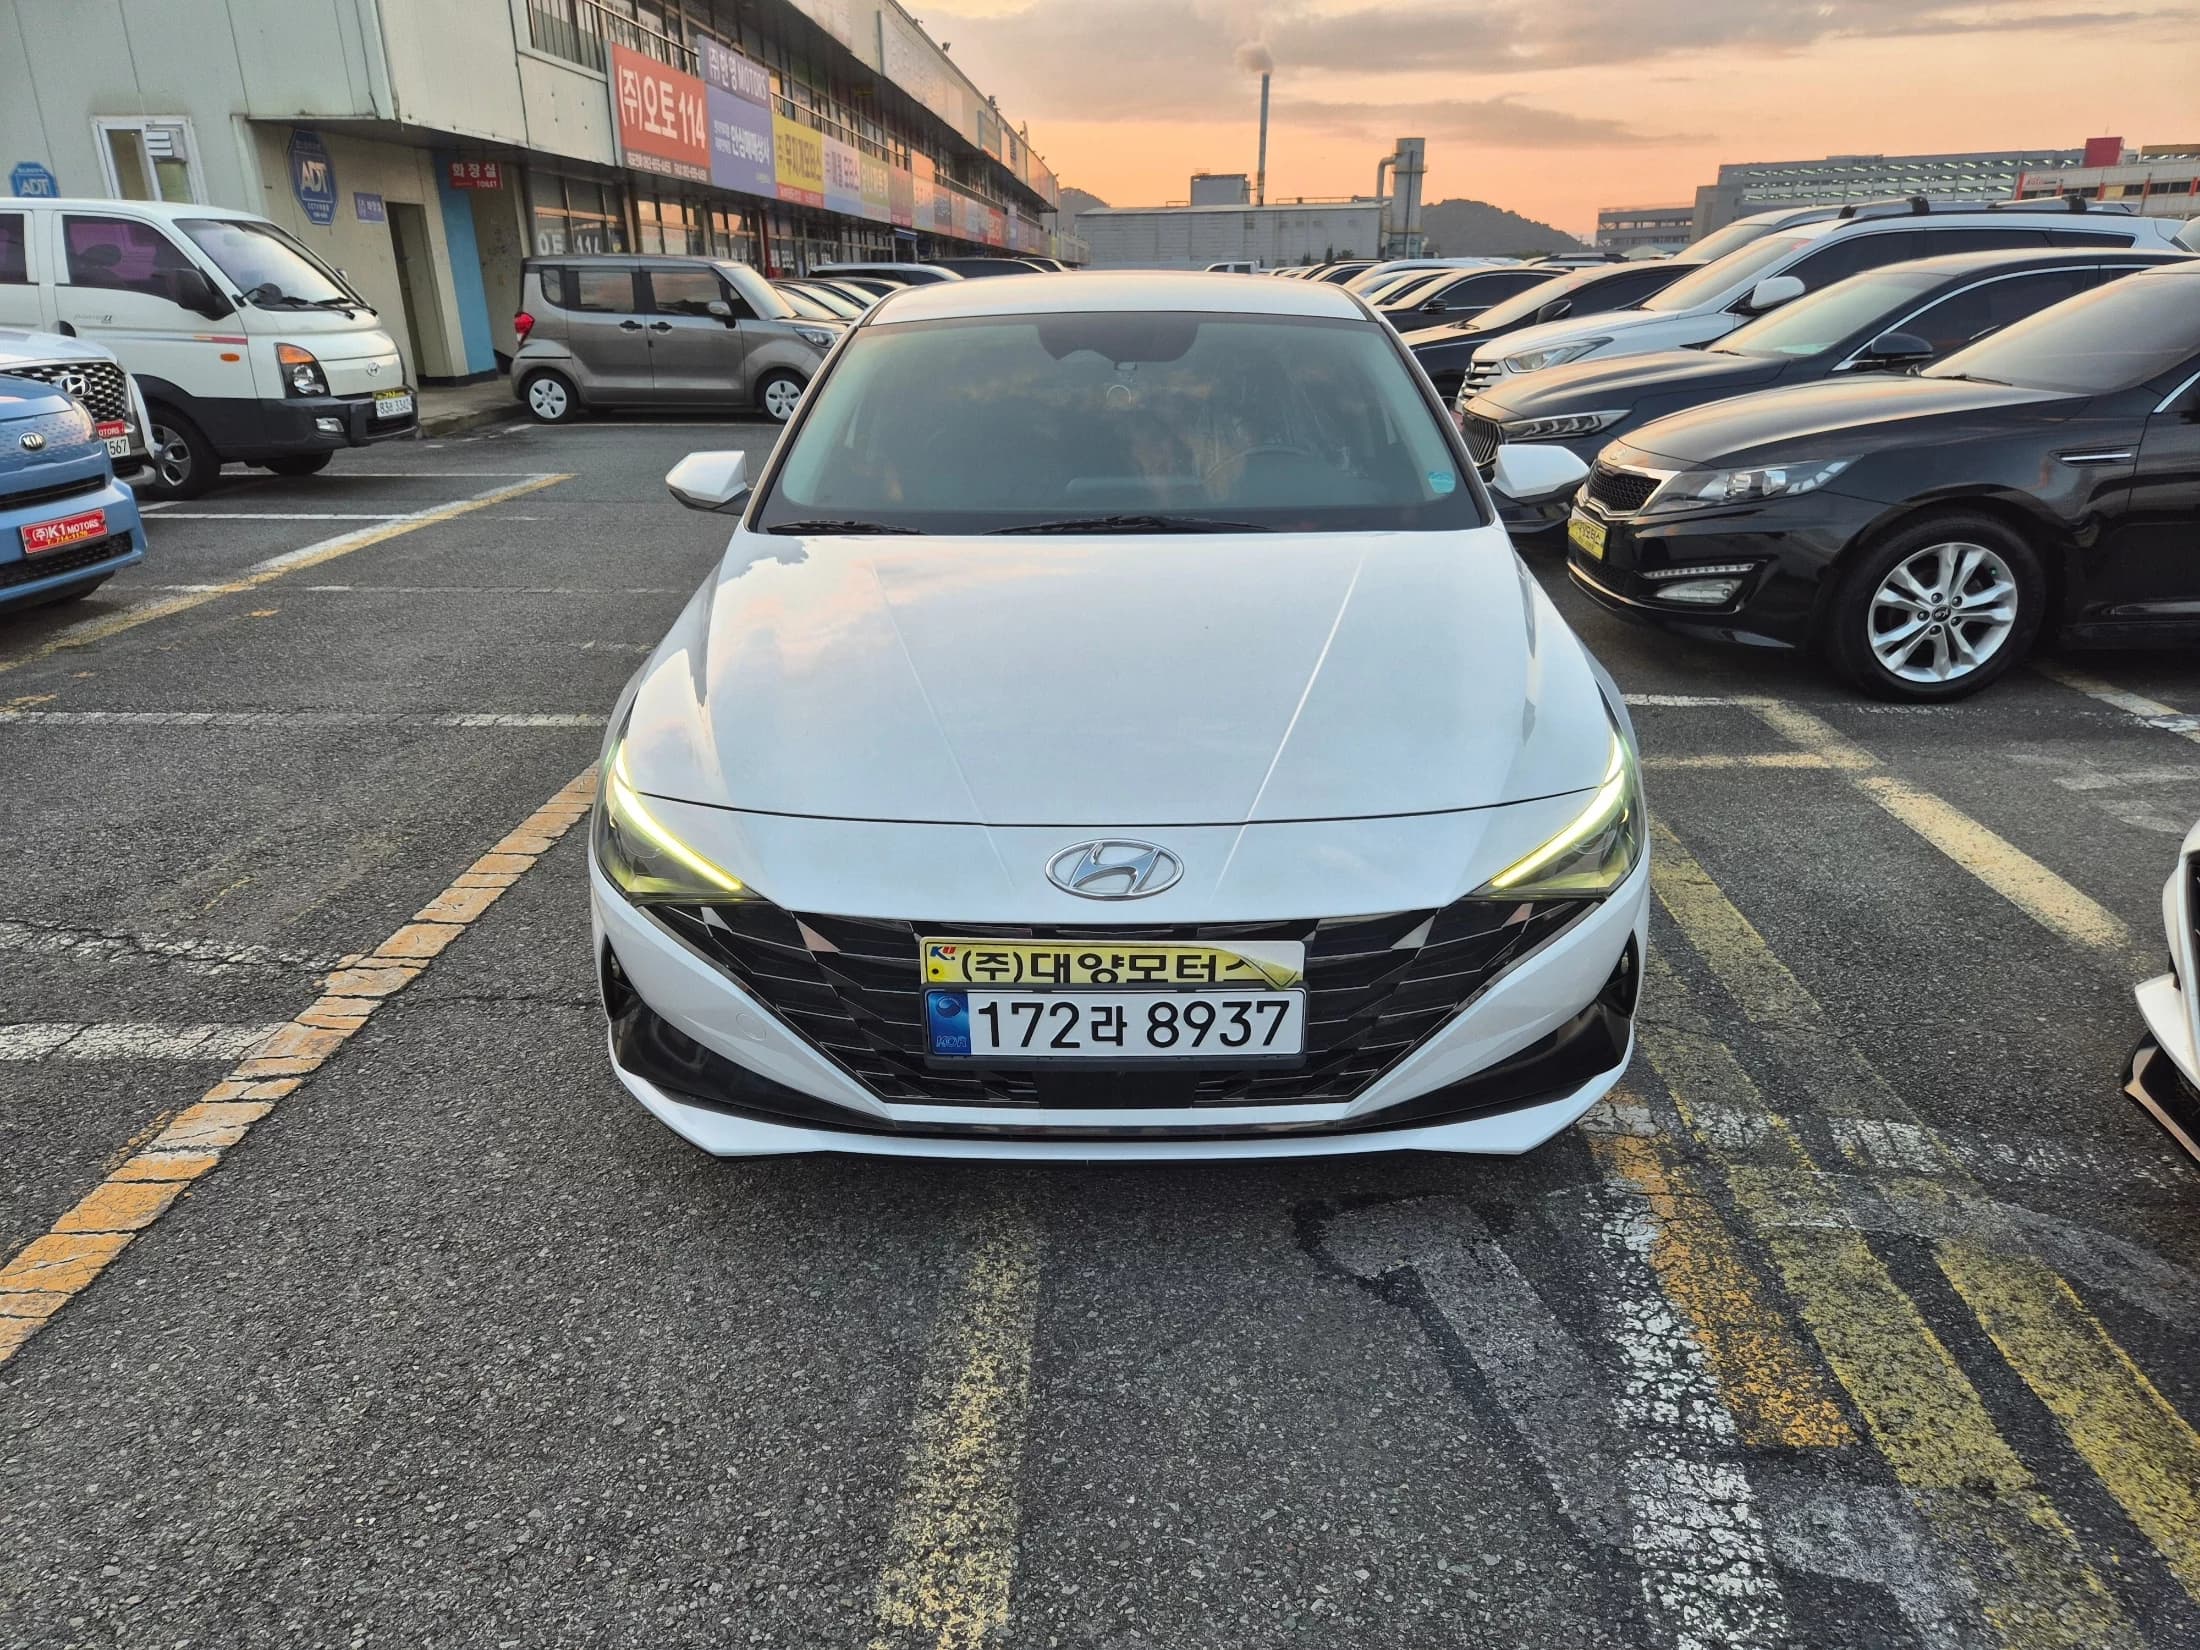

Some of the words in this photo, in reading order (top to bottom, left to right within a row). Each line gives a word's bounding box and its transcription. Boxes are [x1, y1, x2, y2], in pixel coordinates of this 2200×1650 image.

[618, 64, 678, 140] (주)오토
[678, 91, 706, 149] 114
[302, 160, 328, 193] ADT
[452, 163, 497, 178] 화장실
[21, 178, 49, 197] ADT
[98, 426, 120, 437] OTORS
[22, 434, 44, 448] KIA
[109, 438, 127, 456] 567
[67, 519, 99, 534] MOTORS
[978, 1001, 1128, 1049] 172라
[1146, 1001, 1291, 1048] 8937
